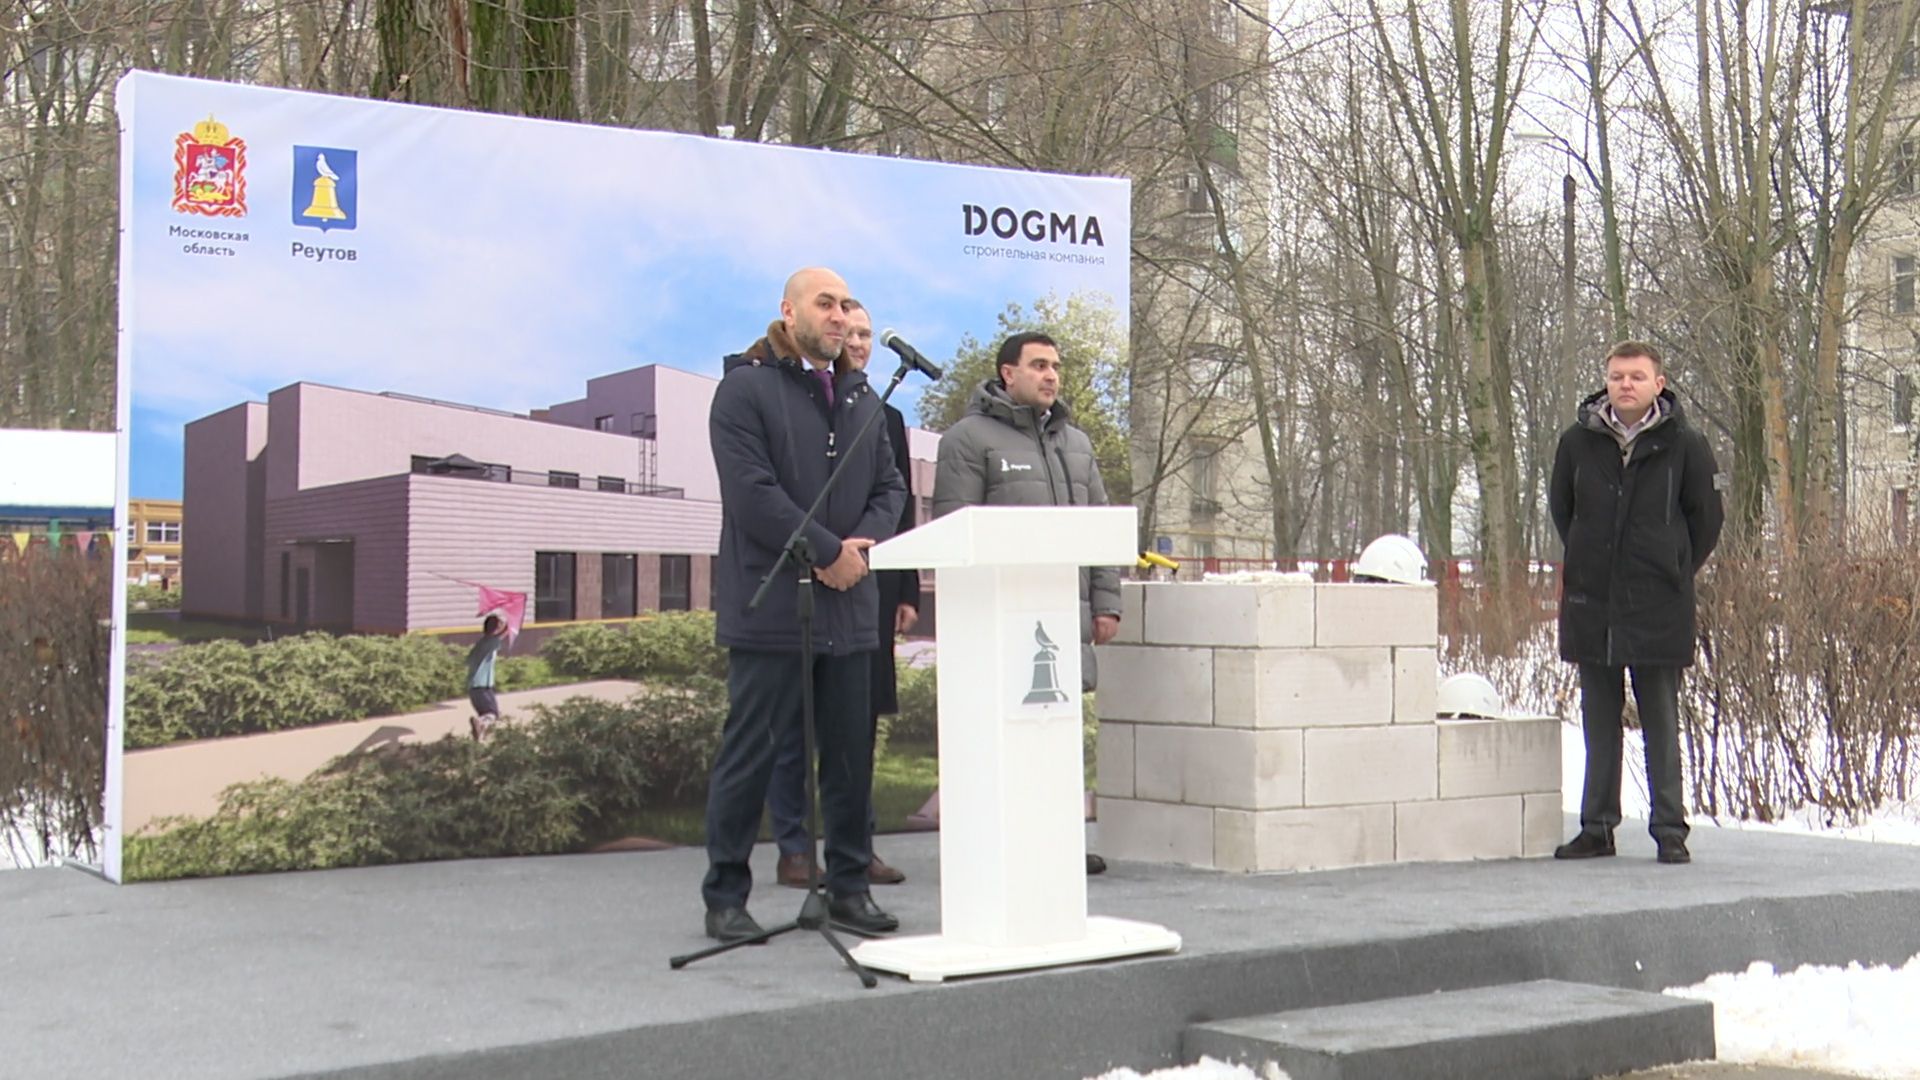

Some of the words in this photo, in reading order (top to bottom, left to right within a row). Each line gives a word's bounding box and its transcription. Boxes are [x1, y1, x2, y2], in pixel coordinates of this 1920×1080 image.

[169, 226, 249, 241] Московская
[962, 204, 1104, 247] DOGMA
[183, 244, 235, 257] область
[292, 242, 357, 262] Реутов
[963, 245, 1046, 261] строительная
[1050, 252, 1105, 265] компания
